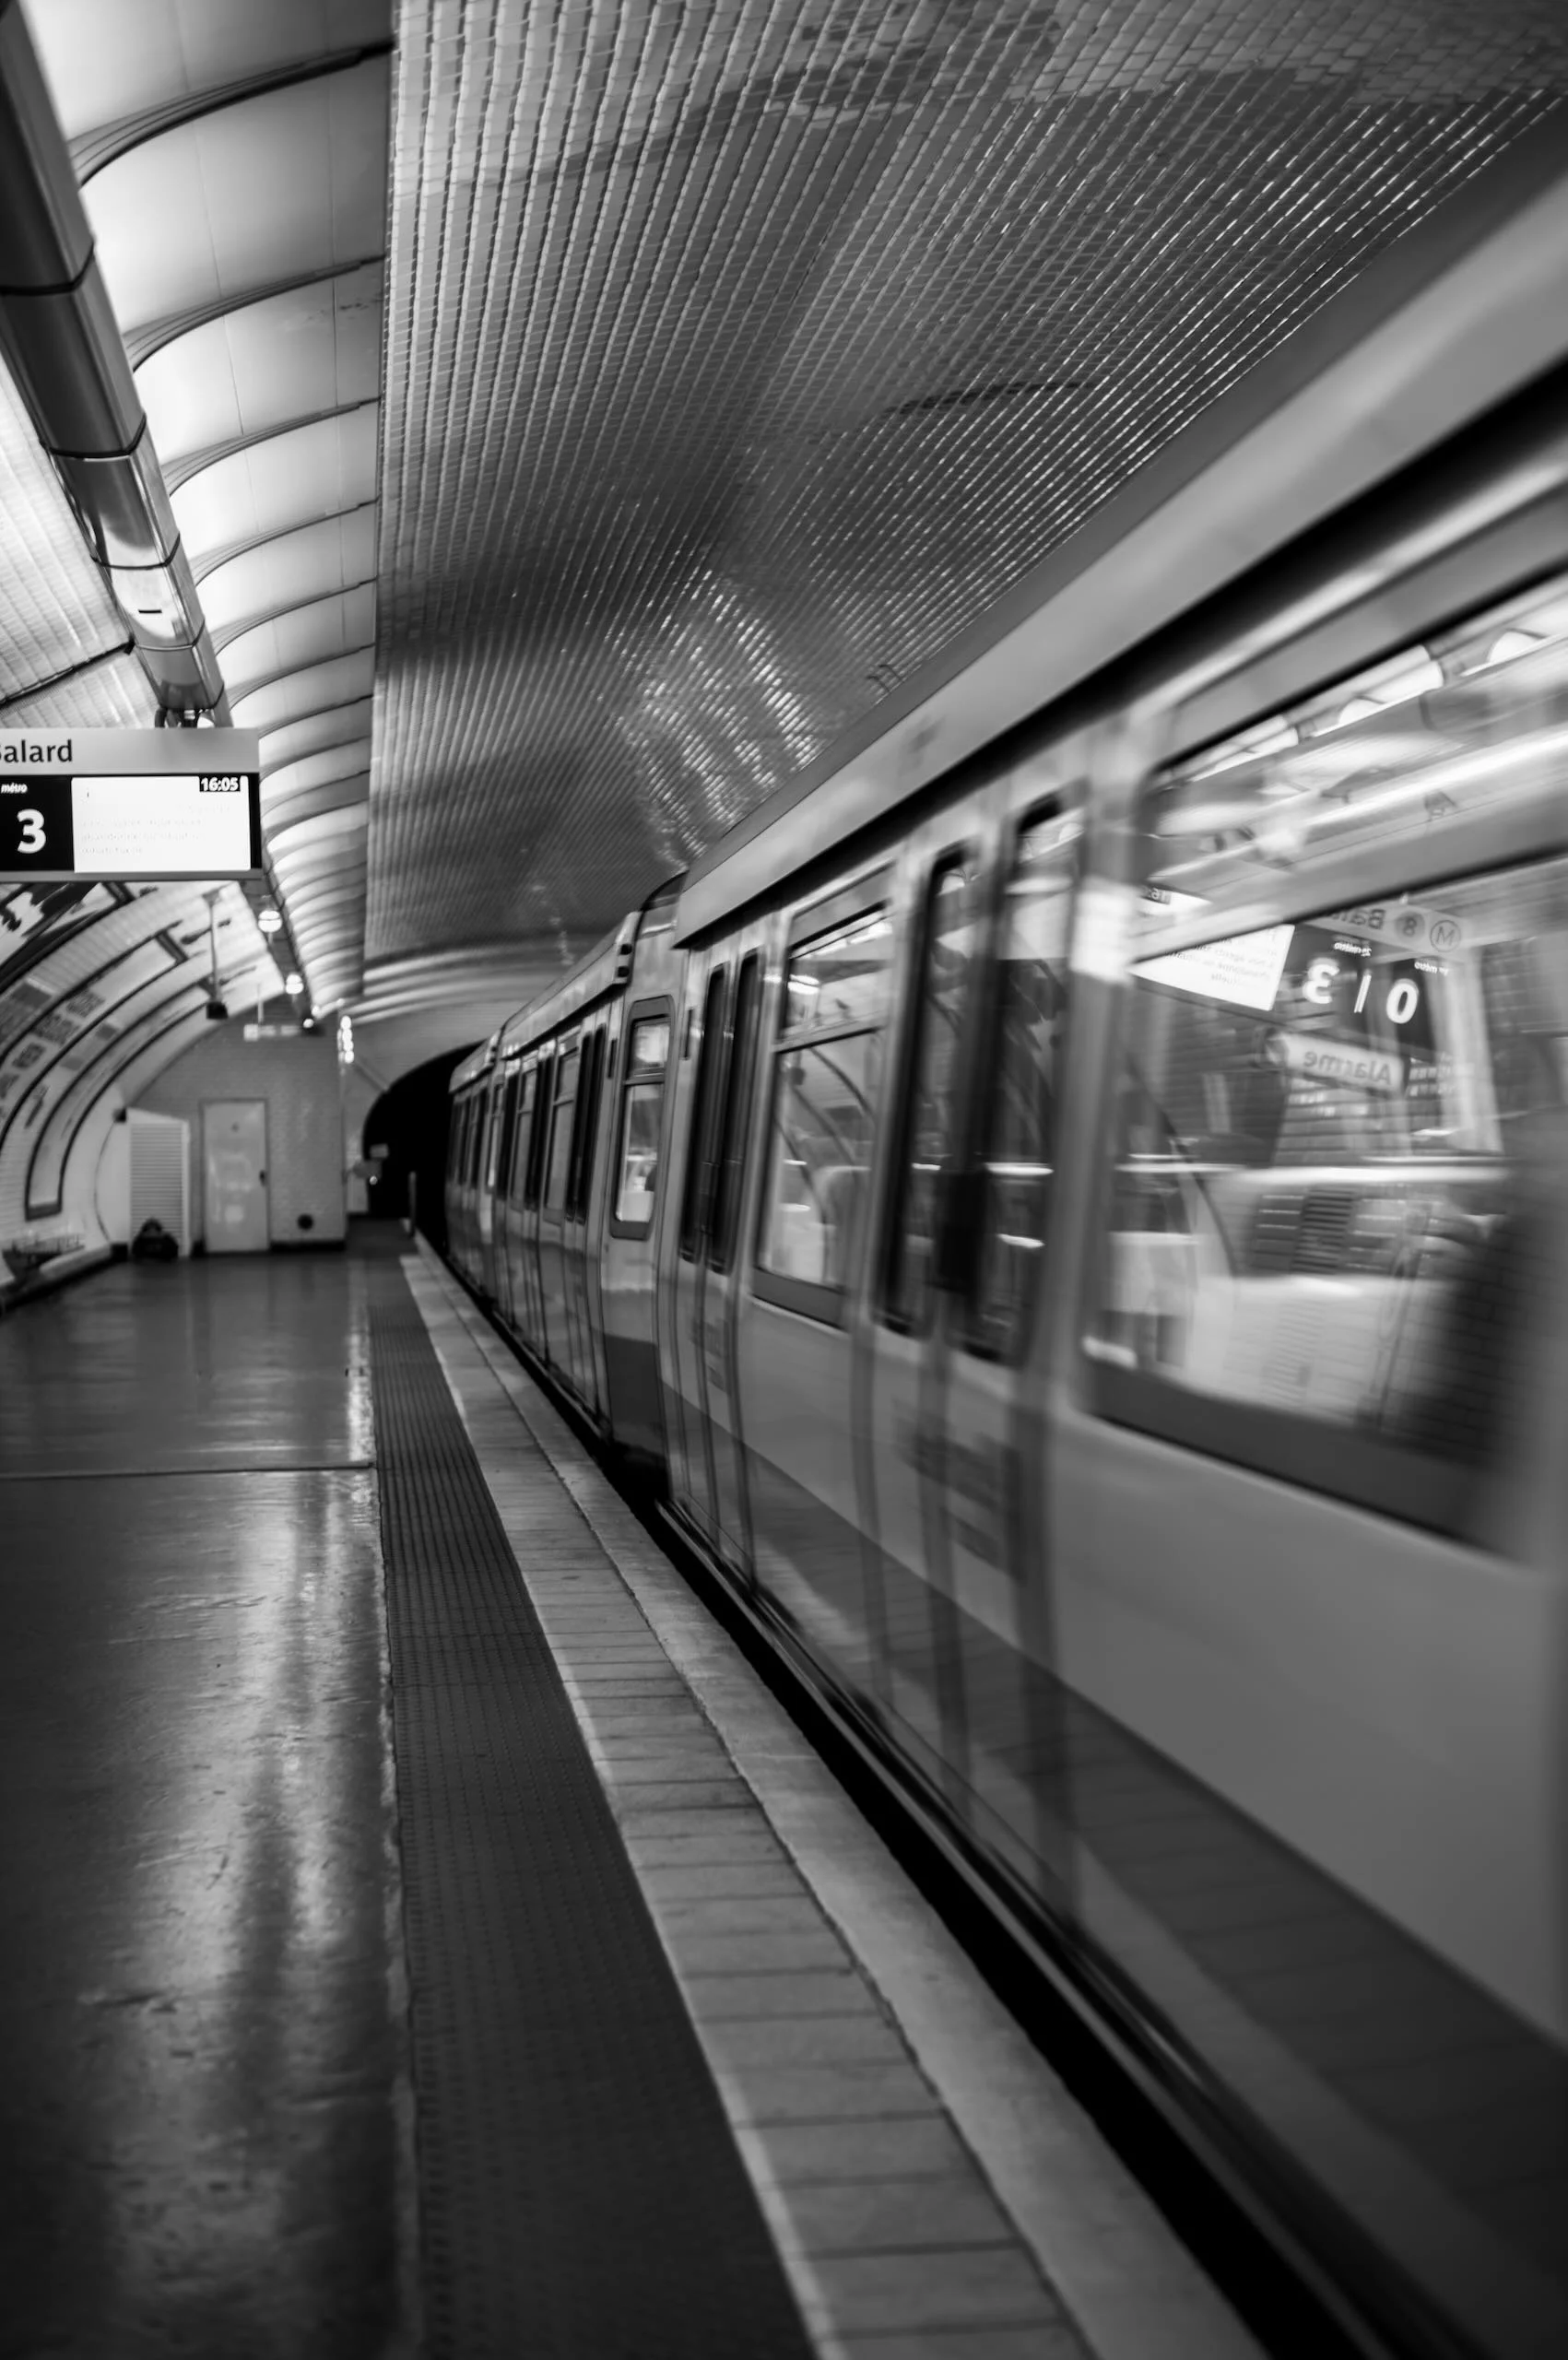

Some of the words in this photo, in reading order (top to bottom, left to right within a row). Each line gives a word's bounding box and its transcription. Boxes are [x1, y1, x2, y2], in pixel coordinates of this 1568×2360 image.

[0, 739, 73, 763] alard
[201, 777, 239, 791] 16:05
[17, 808, 47, 854] 3
